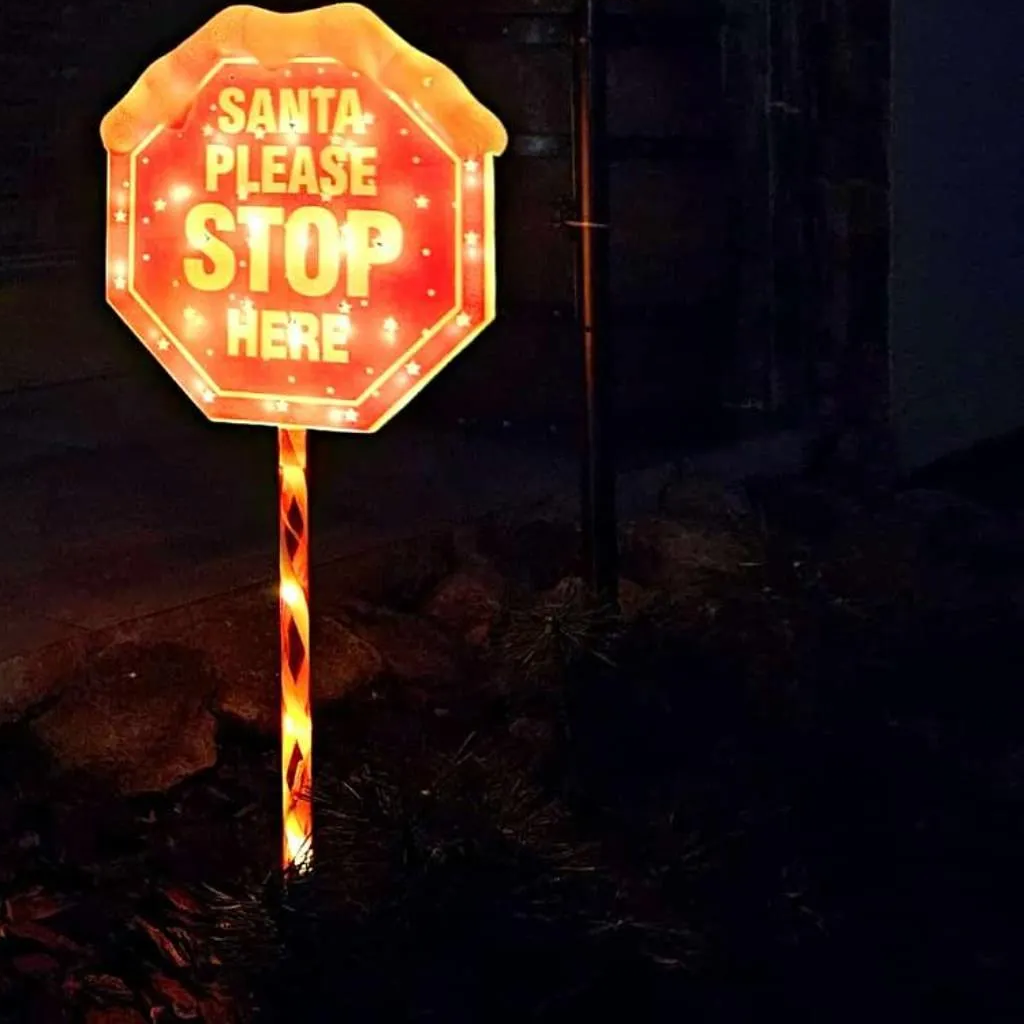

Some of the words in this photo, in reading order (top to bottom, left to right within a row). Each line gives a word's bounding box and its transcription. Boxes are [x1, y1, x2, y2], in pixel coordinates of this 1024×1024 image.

[218, 87, 365, 134] SANTA
[205, 144, 376, 196] PLEASE
[183, 202, 403, 297] STOP
[227, 308, 349, 363] HERE
